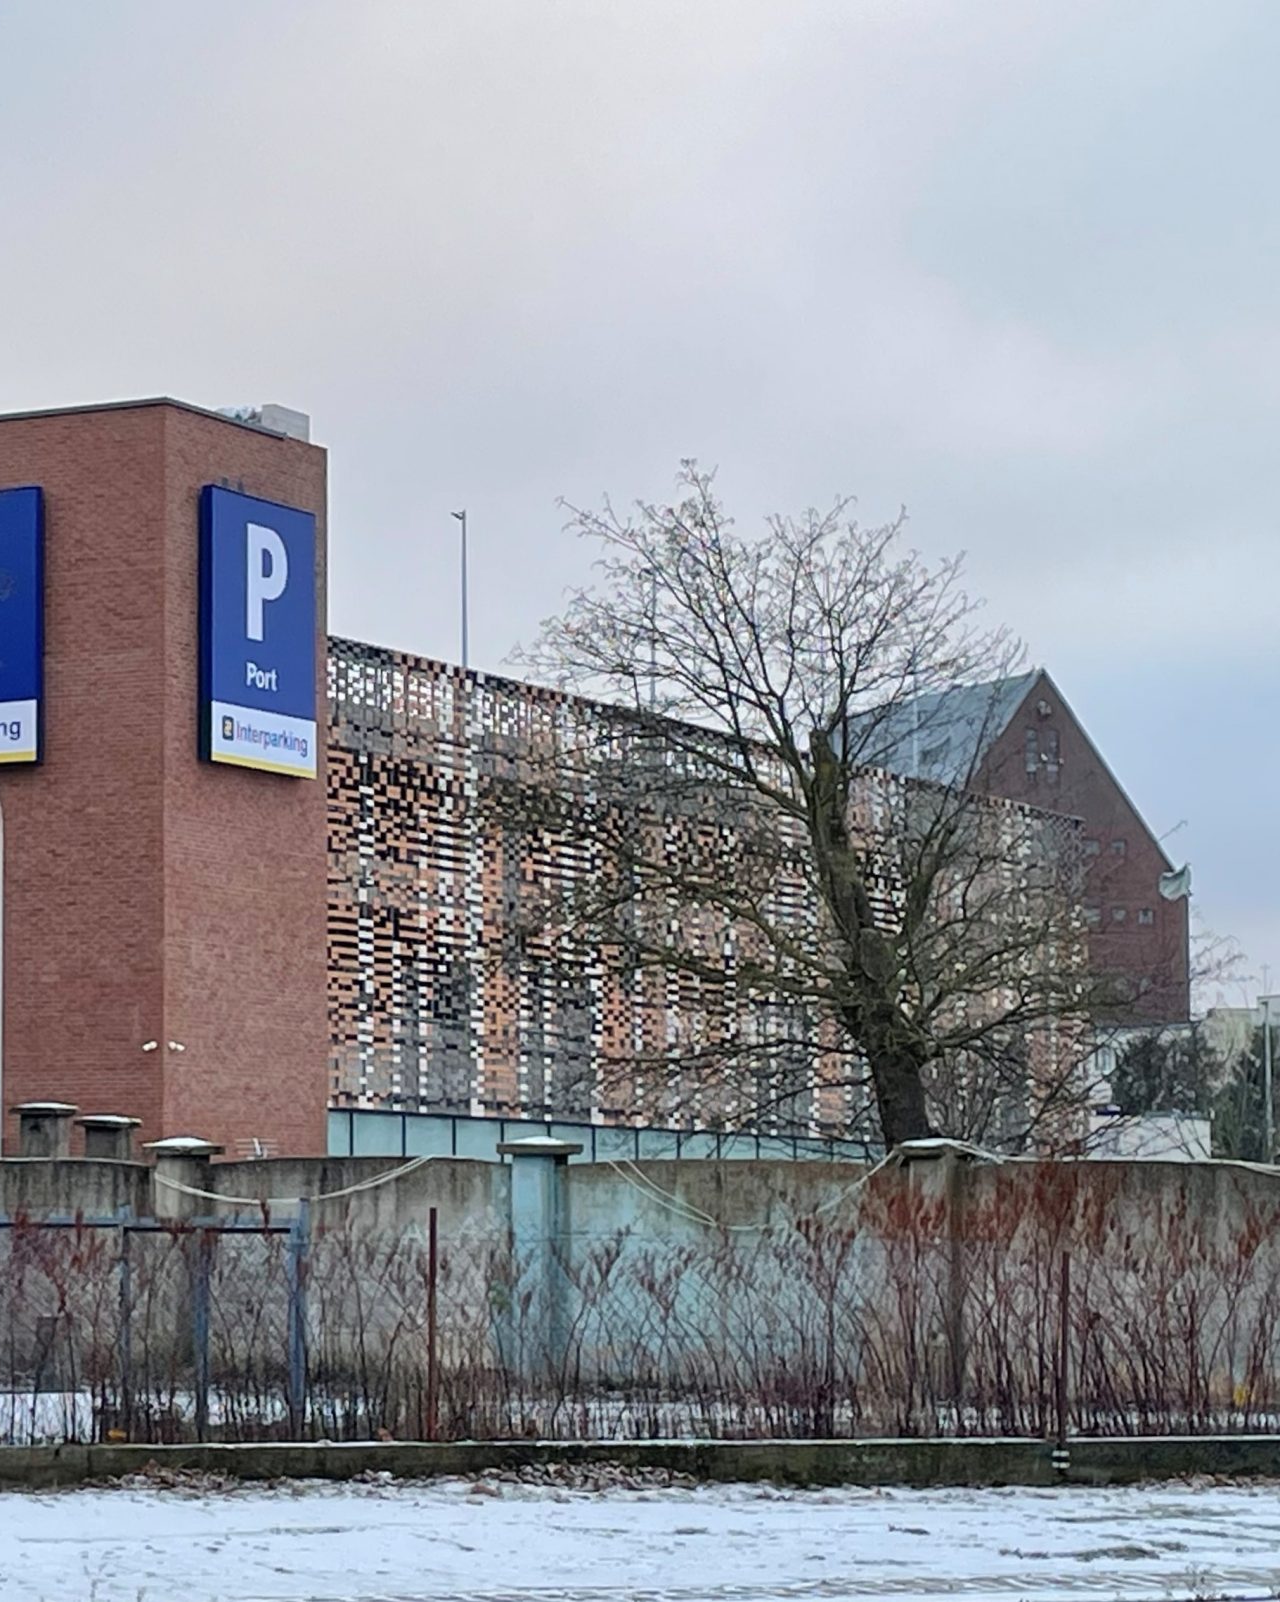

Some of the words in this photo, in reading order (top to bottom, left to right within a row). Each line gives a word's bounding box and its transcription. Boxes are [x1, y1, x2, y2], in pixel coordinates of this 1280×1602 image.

[246, 521, 288, 641] P
[245, 661, 278, 692] Port
[235, 720, 309, 758] Interparking
